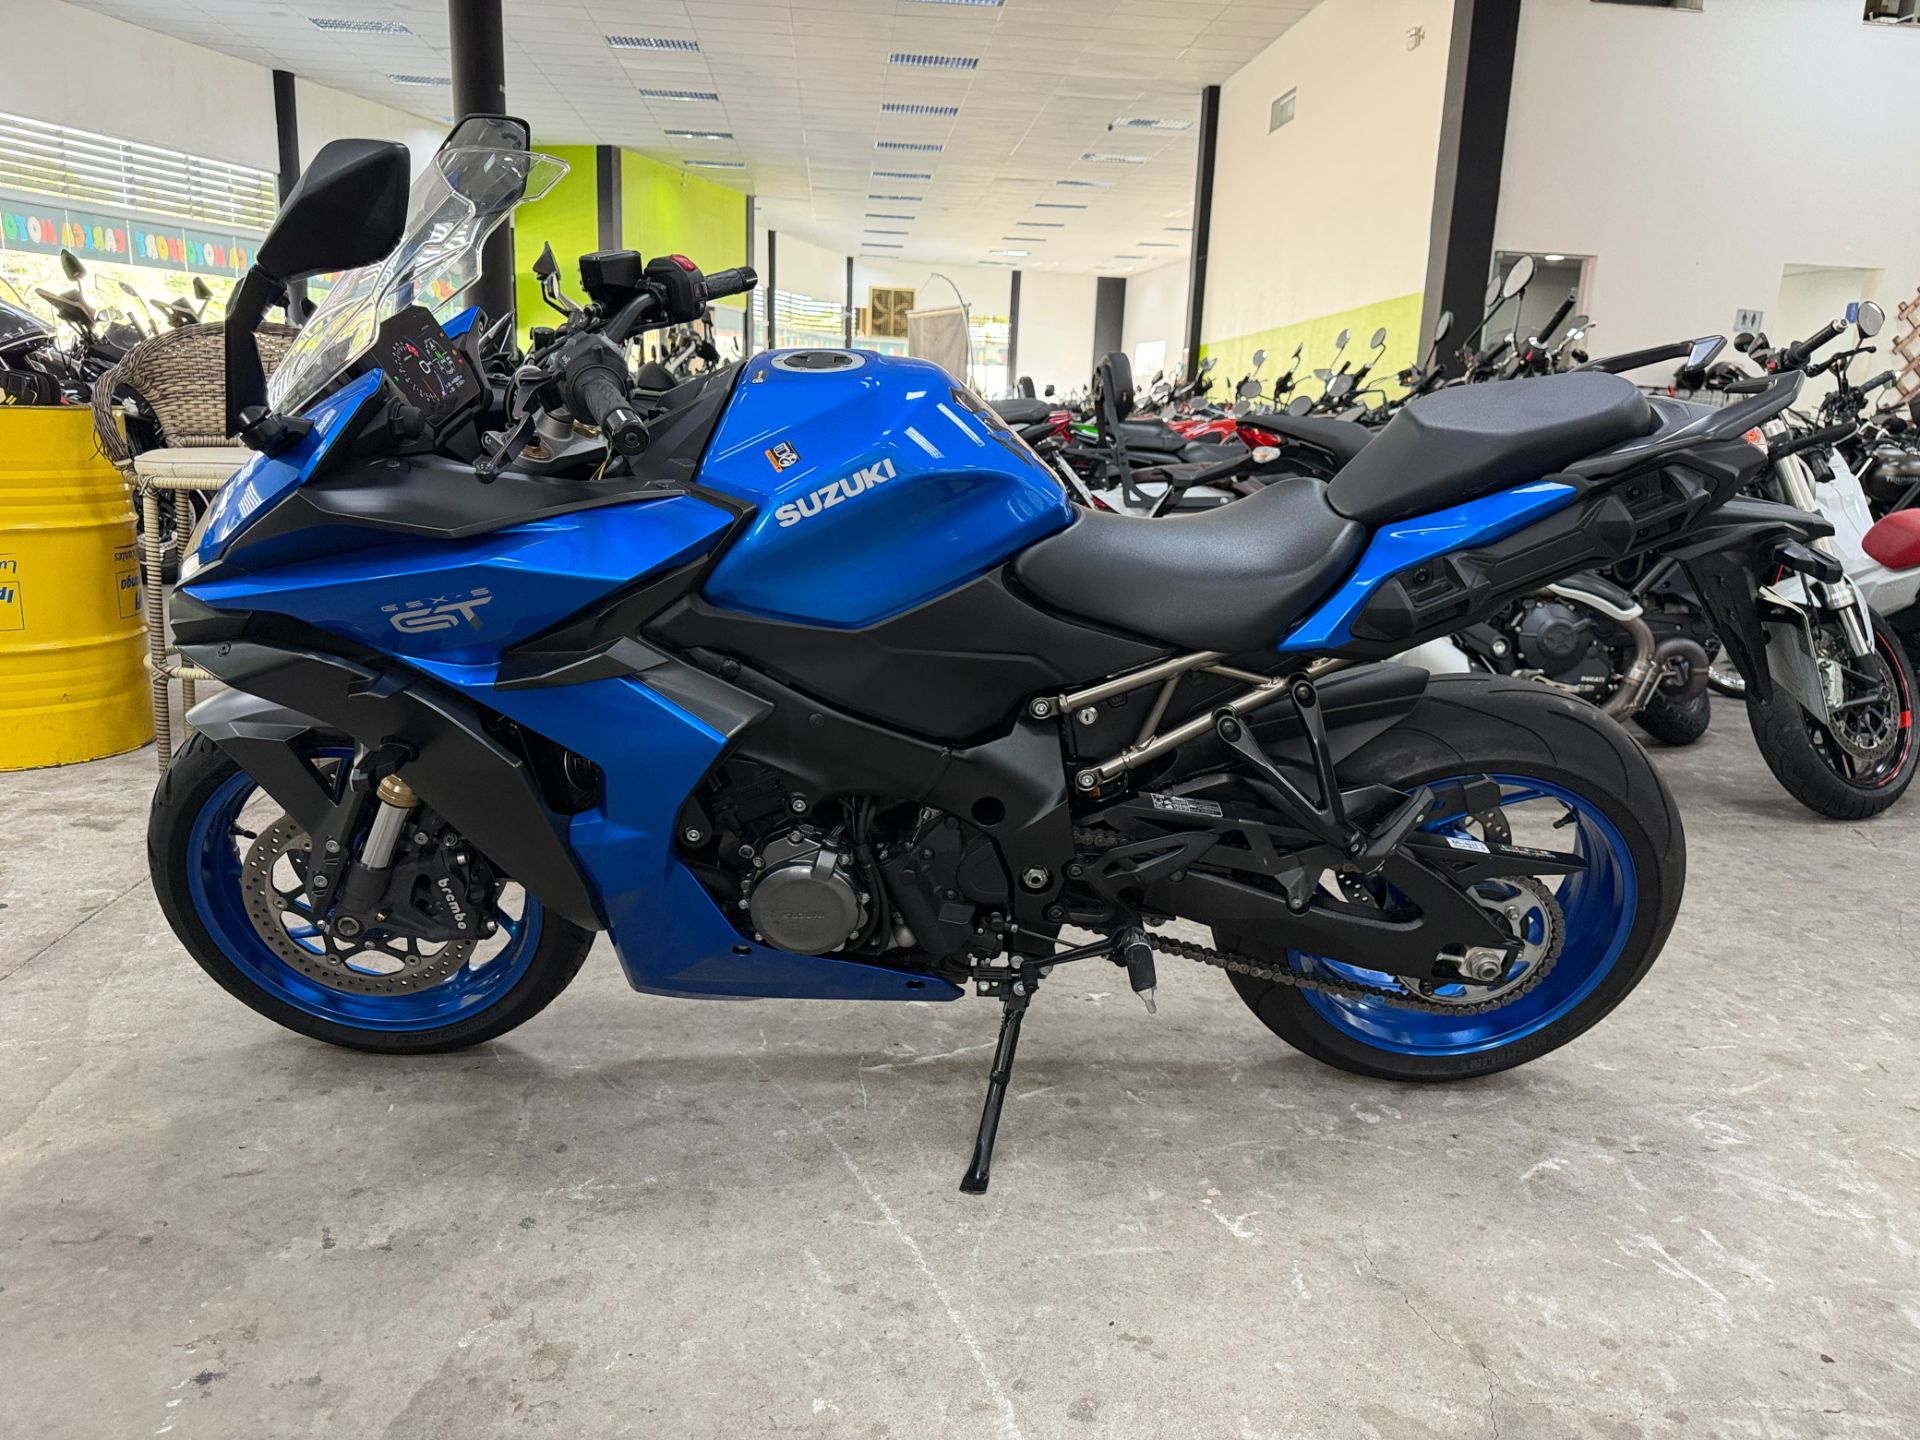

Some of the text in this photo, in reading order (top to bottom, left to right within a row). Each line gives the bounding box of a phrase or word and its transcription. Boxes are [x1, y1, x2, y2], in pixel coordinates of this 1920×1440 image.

[775, 458, 897, 528] SUZUKI
[390, 596, 492, 633] GT
[437, 877, 467, 930] brembo
